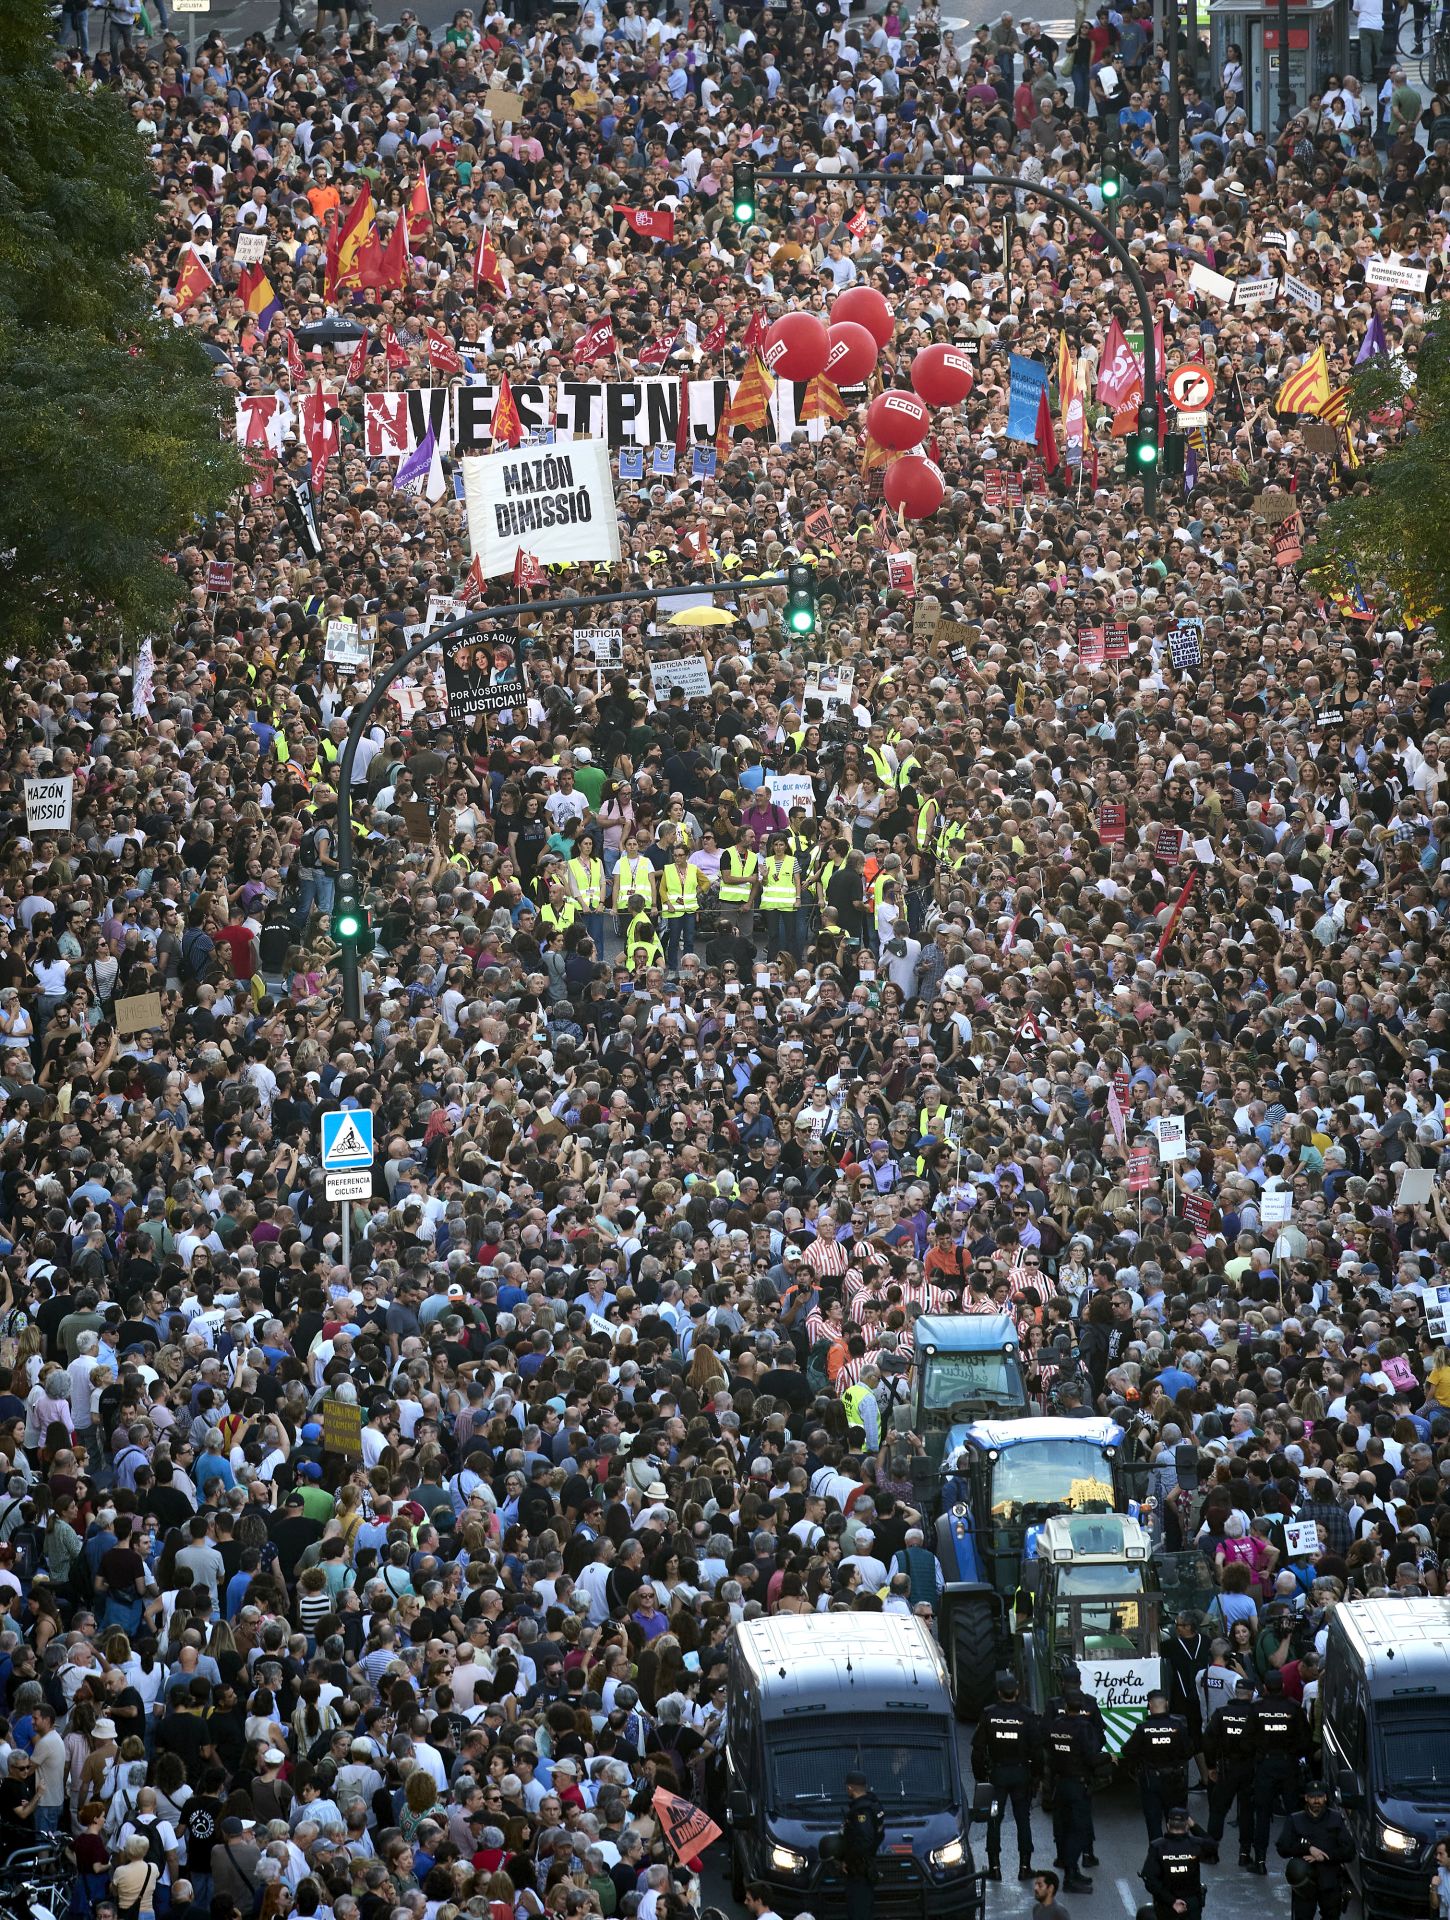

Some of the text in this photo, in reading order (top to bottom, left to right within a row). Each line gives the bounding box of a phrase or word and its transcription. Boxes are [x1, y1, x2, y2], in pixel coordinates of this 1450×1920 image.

[1371, 274, 1399, 284] TOREROS
[1372, 267, 1405, 278] BOMBEROS
[888, 398, 922, 416] CCOO
[502, 453, 574, 497] MAZÓN
[494, 485, 591, 538] DIMISSIÓ
[575, 630, 622, 638] JUSTICIA
[447, 634, 489, 658] ESTAMOS
[492, 633, 517, 645] AQUÍ
[653, 661, 682, 670] JUSTICIA
[450, 691, 470, 701] POR
[472, 682, 522, 698] VOSOTROS
[463, 693, 526, 713] JUSTICIA!!!
[28, 783, 64, 801] MAZÓN
[773, 781, 781, 791] EL
[782, 782, 794, 791] QUE
[327, 1177, 371, 1187] PREFERENCIA
[334, 1187, 363, 1196] CICLISTA
[593, 1318, 610, 1332] Mazón
[1393, 1363, 1410, 1379] 4
[1094, 1669, 1144, 1688] Horta
